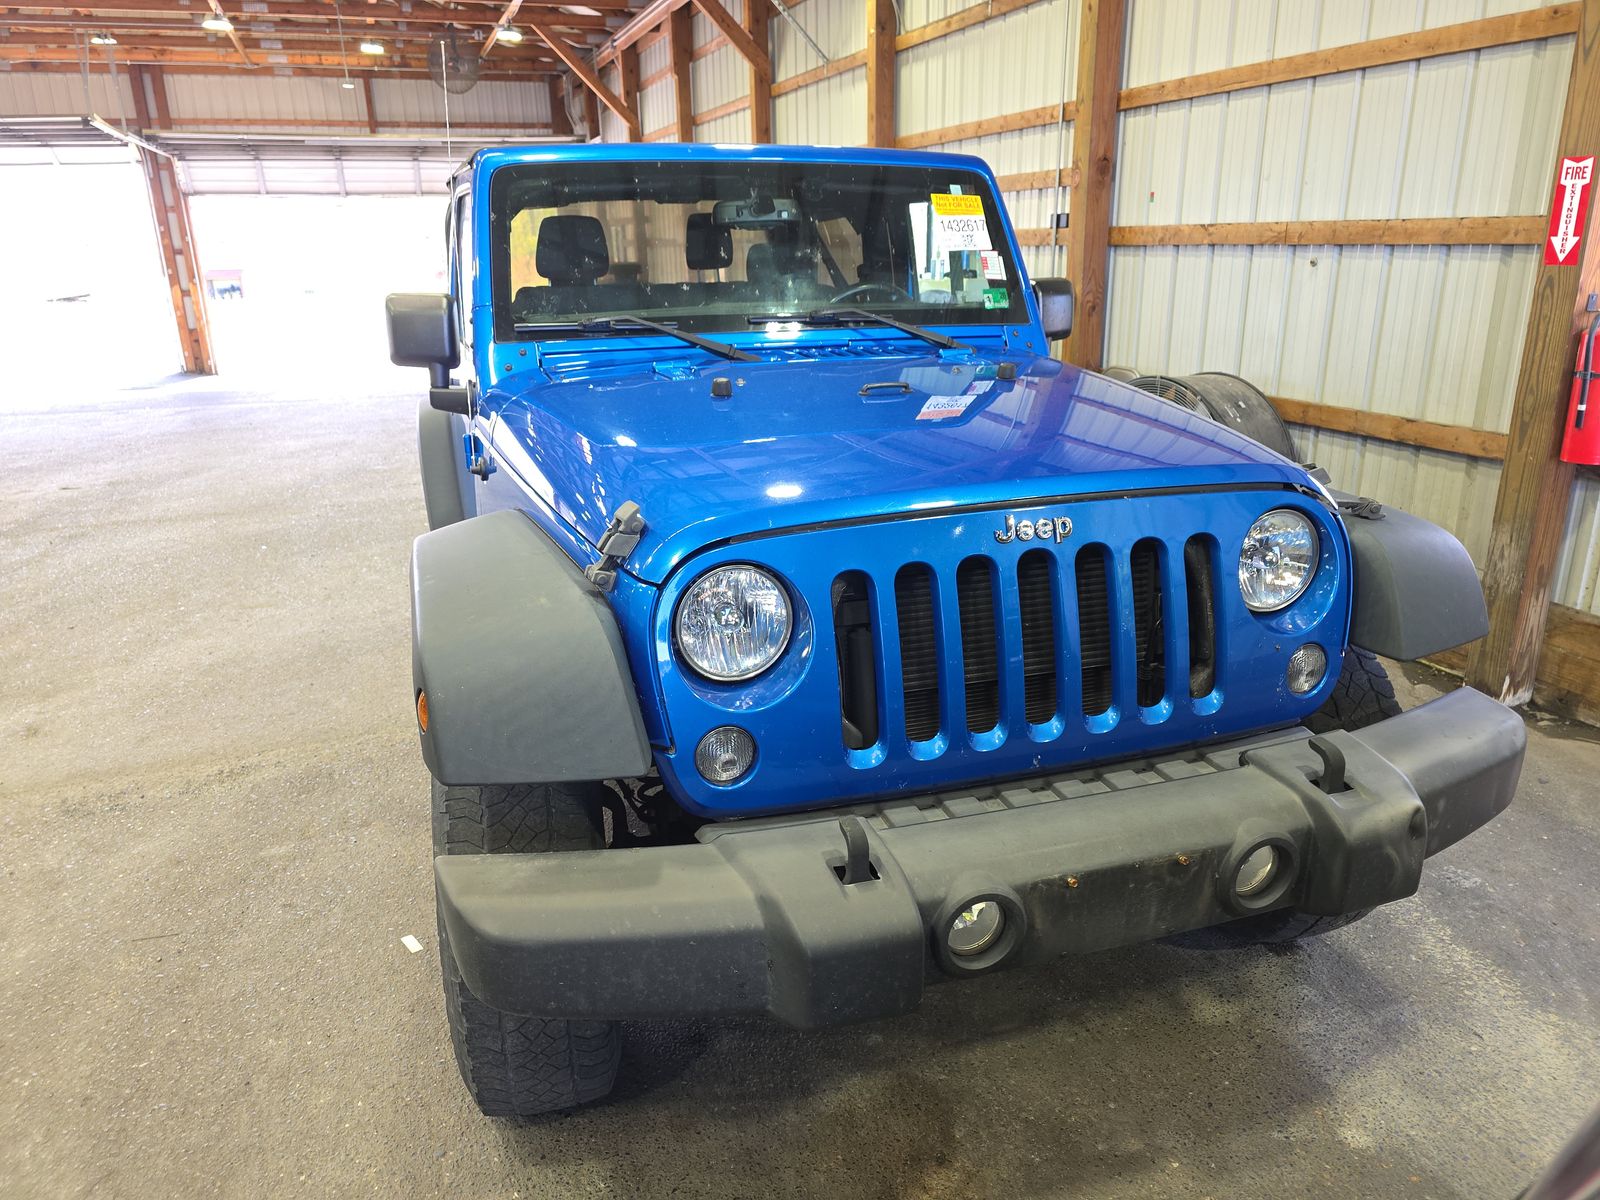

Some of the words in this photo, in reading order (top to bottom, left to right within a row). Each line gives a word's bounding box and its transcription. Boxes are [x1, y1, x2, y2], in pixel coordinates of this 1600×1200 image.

[1564, 166, 1589, 180] FIRE
[940, 219, 985, 232] 1432617
[1559, 183, 1577, 254] EXTINGUISHER
[994, 514, 1073, 544] Jeep
